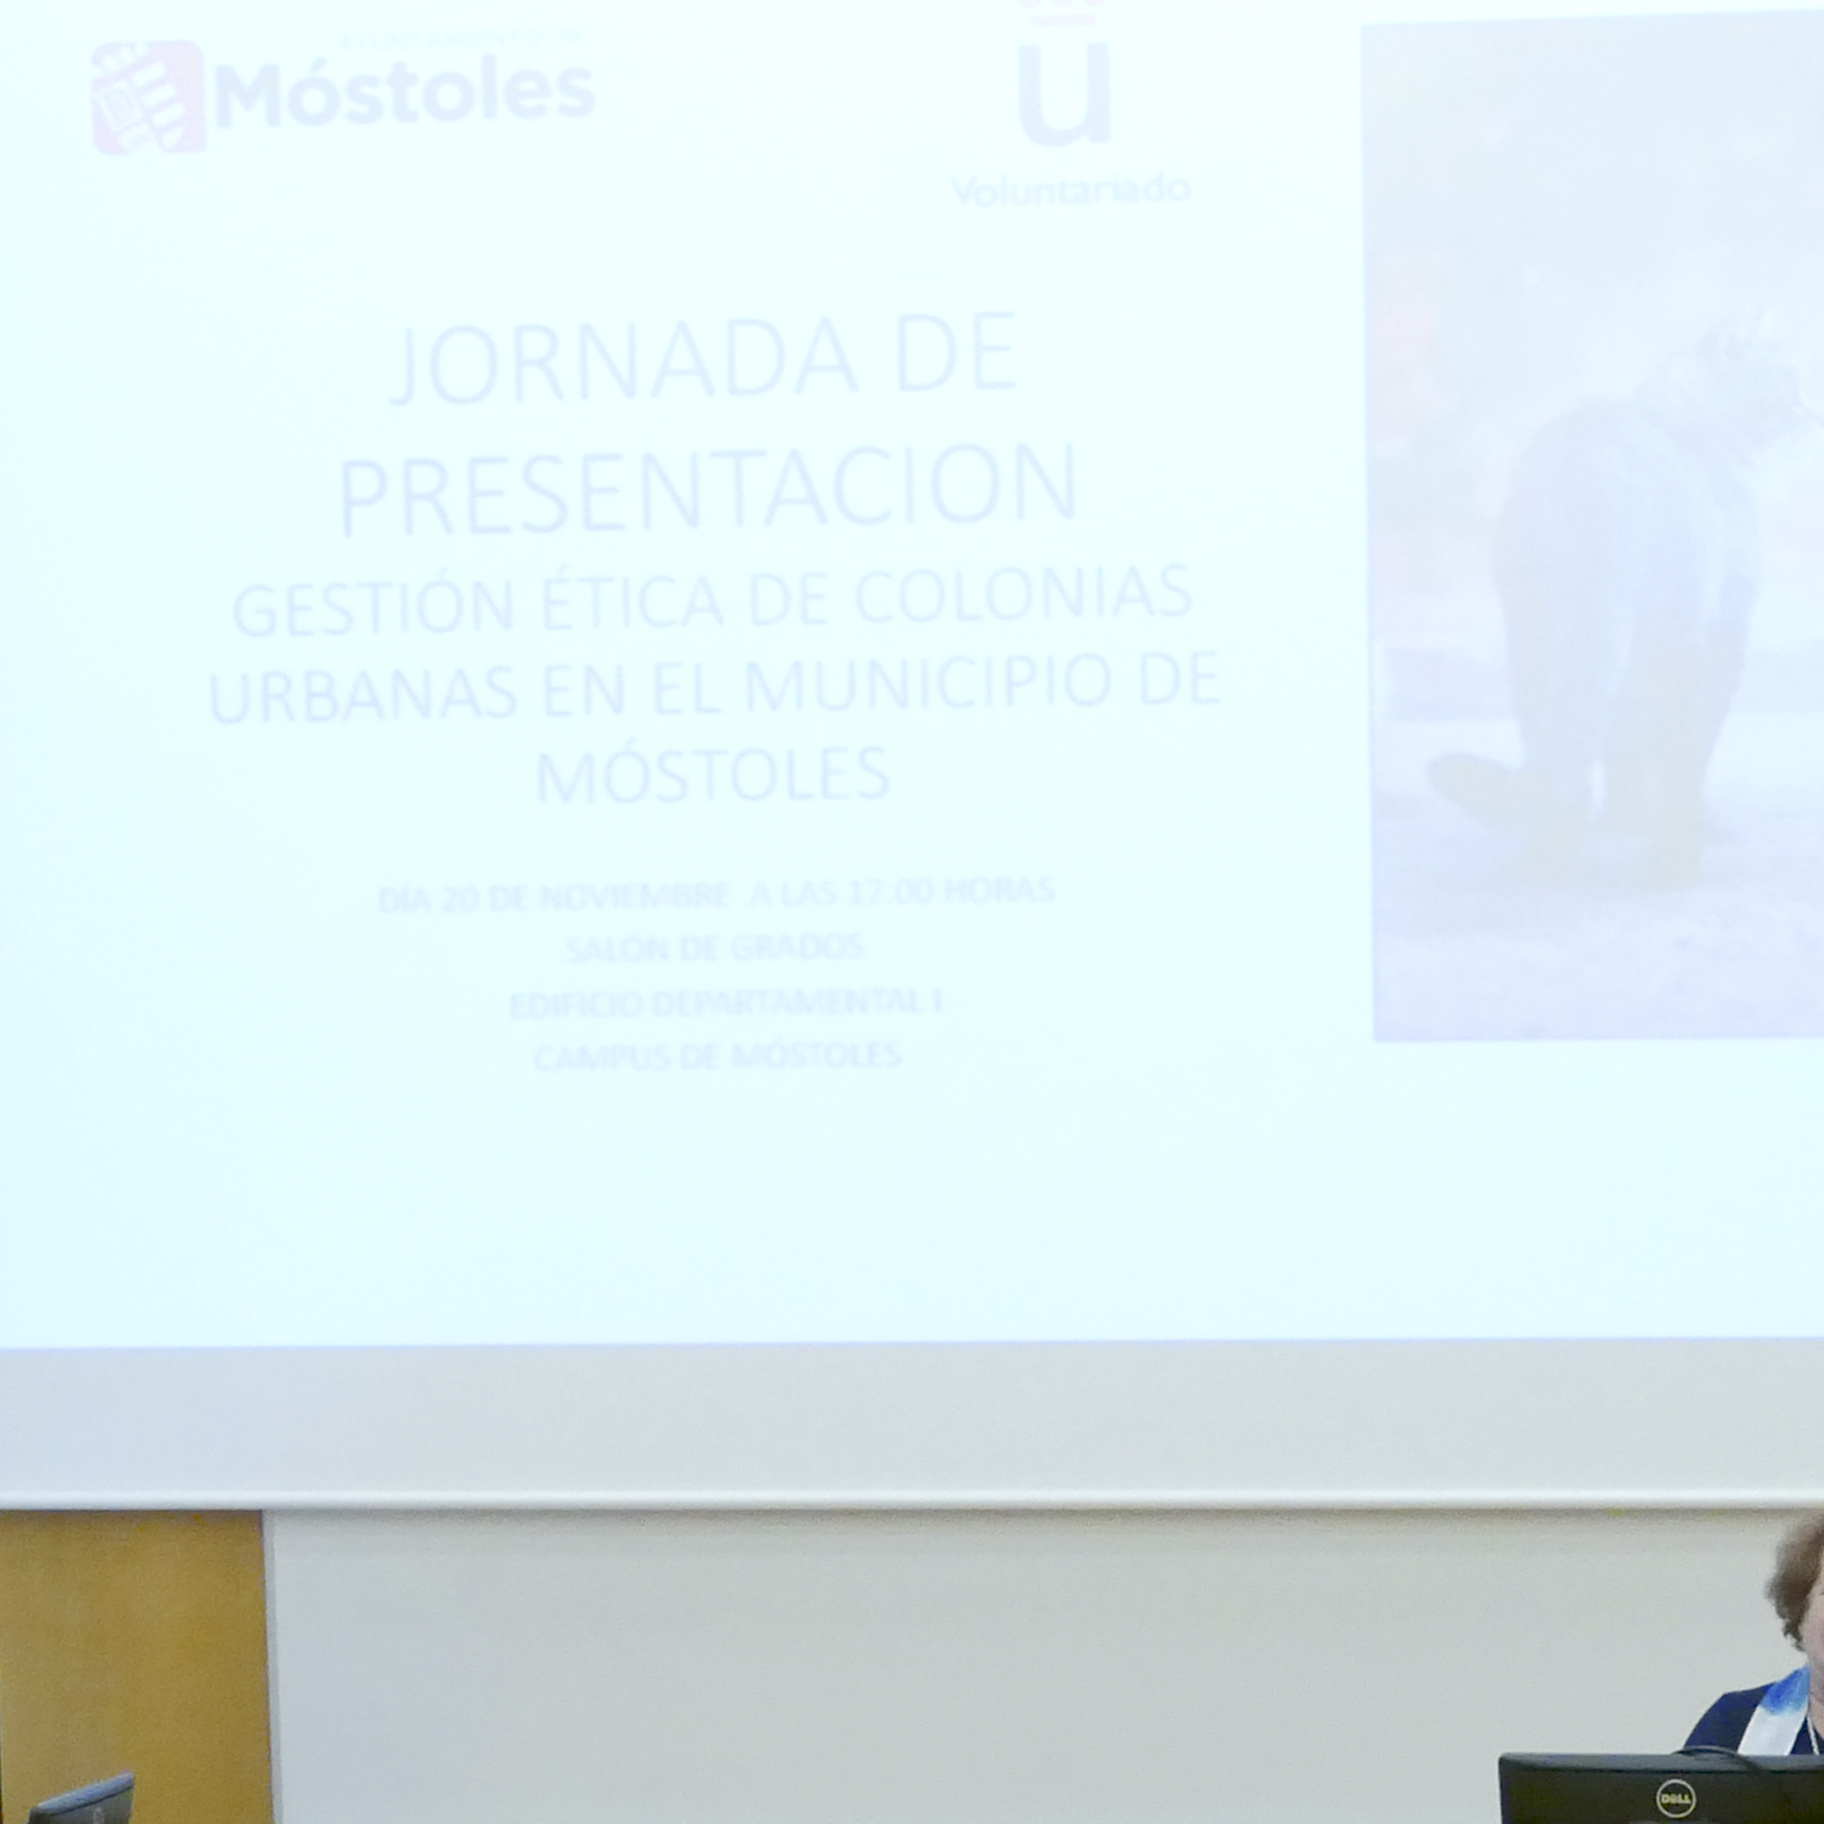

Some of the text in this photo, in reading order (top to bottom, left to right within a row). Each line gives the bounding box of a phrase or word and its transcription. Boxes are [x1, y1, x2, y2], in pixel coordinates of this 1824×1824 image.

[215, 54, 595, 129] Móstoles
[950, 170, 1192, 208] Voluntariado
[388, 311, 1016, 407] JORNADA DE
[342, 443, 1074, 538] PRESENTACION
[233, 563, 1192, 638] GESTIÓN ÉTICA DE COLONIAS
[210, 651, 1220, 725] URBANAS EN EL MUNICIPIO DE
[538, 737, 890, 804] MÓSTOLES
[488, 884, 526, 912] DE
[540, 881, 728, 912] NOVIEMBRE
[748, 880, 774, 906] A
[780, 879, 839, 909] LAS
[944, 876, 1057, 905] HORAS
[679, 935, 719, 962] DE
[730, 932, 867, 962] GRADOS
[509, 991, 645, 1020] EDIFICIO
[651, 987, 924, 1018] DEPARTAMENTAL
[533, 1044, 673, 1073] CAMPUS
[680, 1042, 719, 1071] DE
